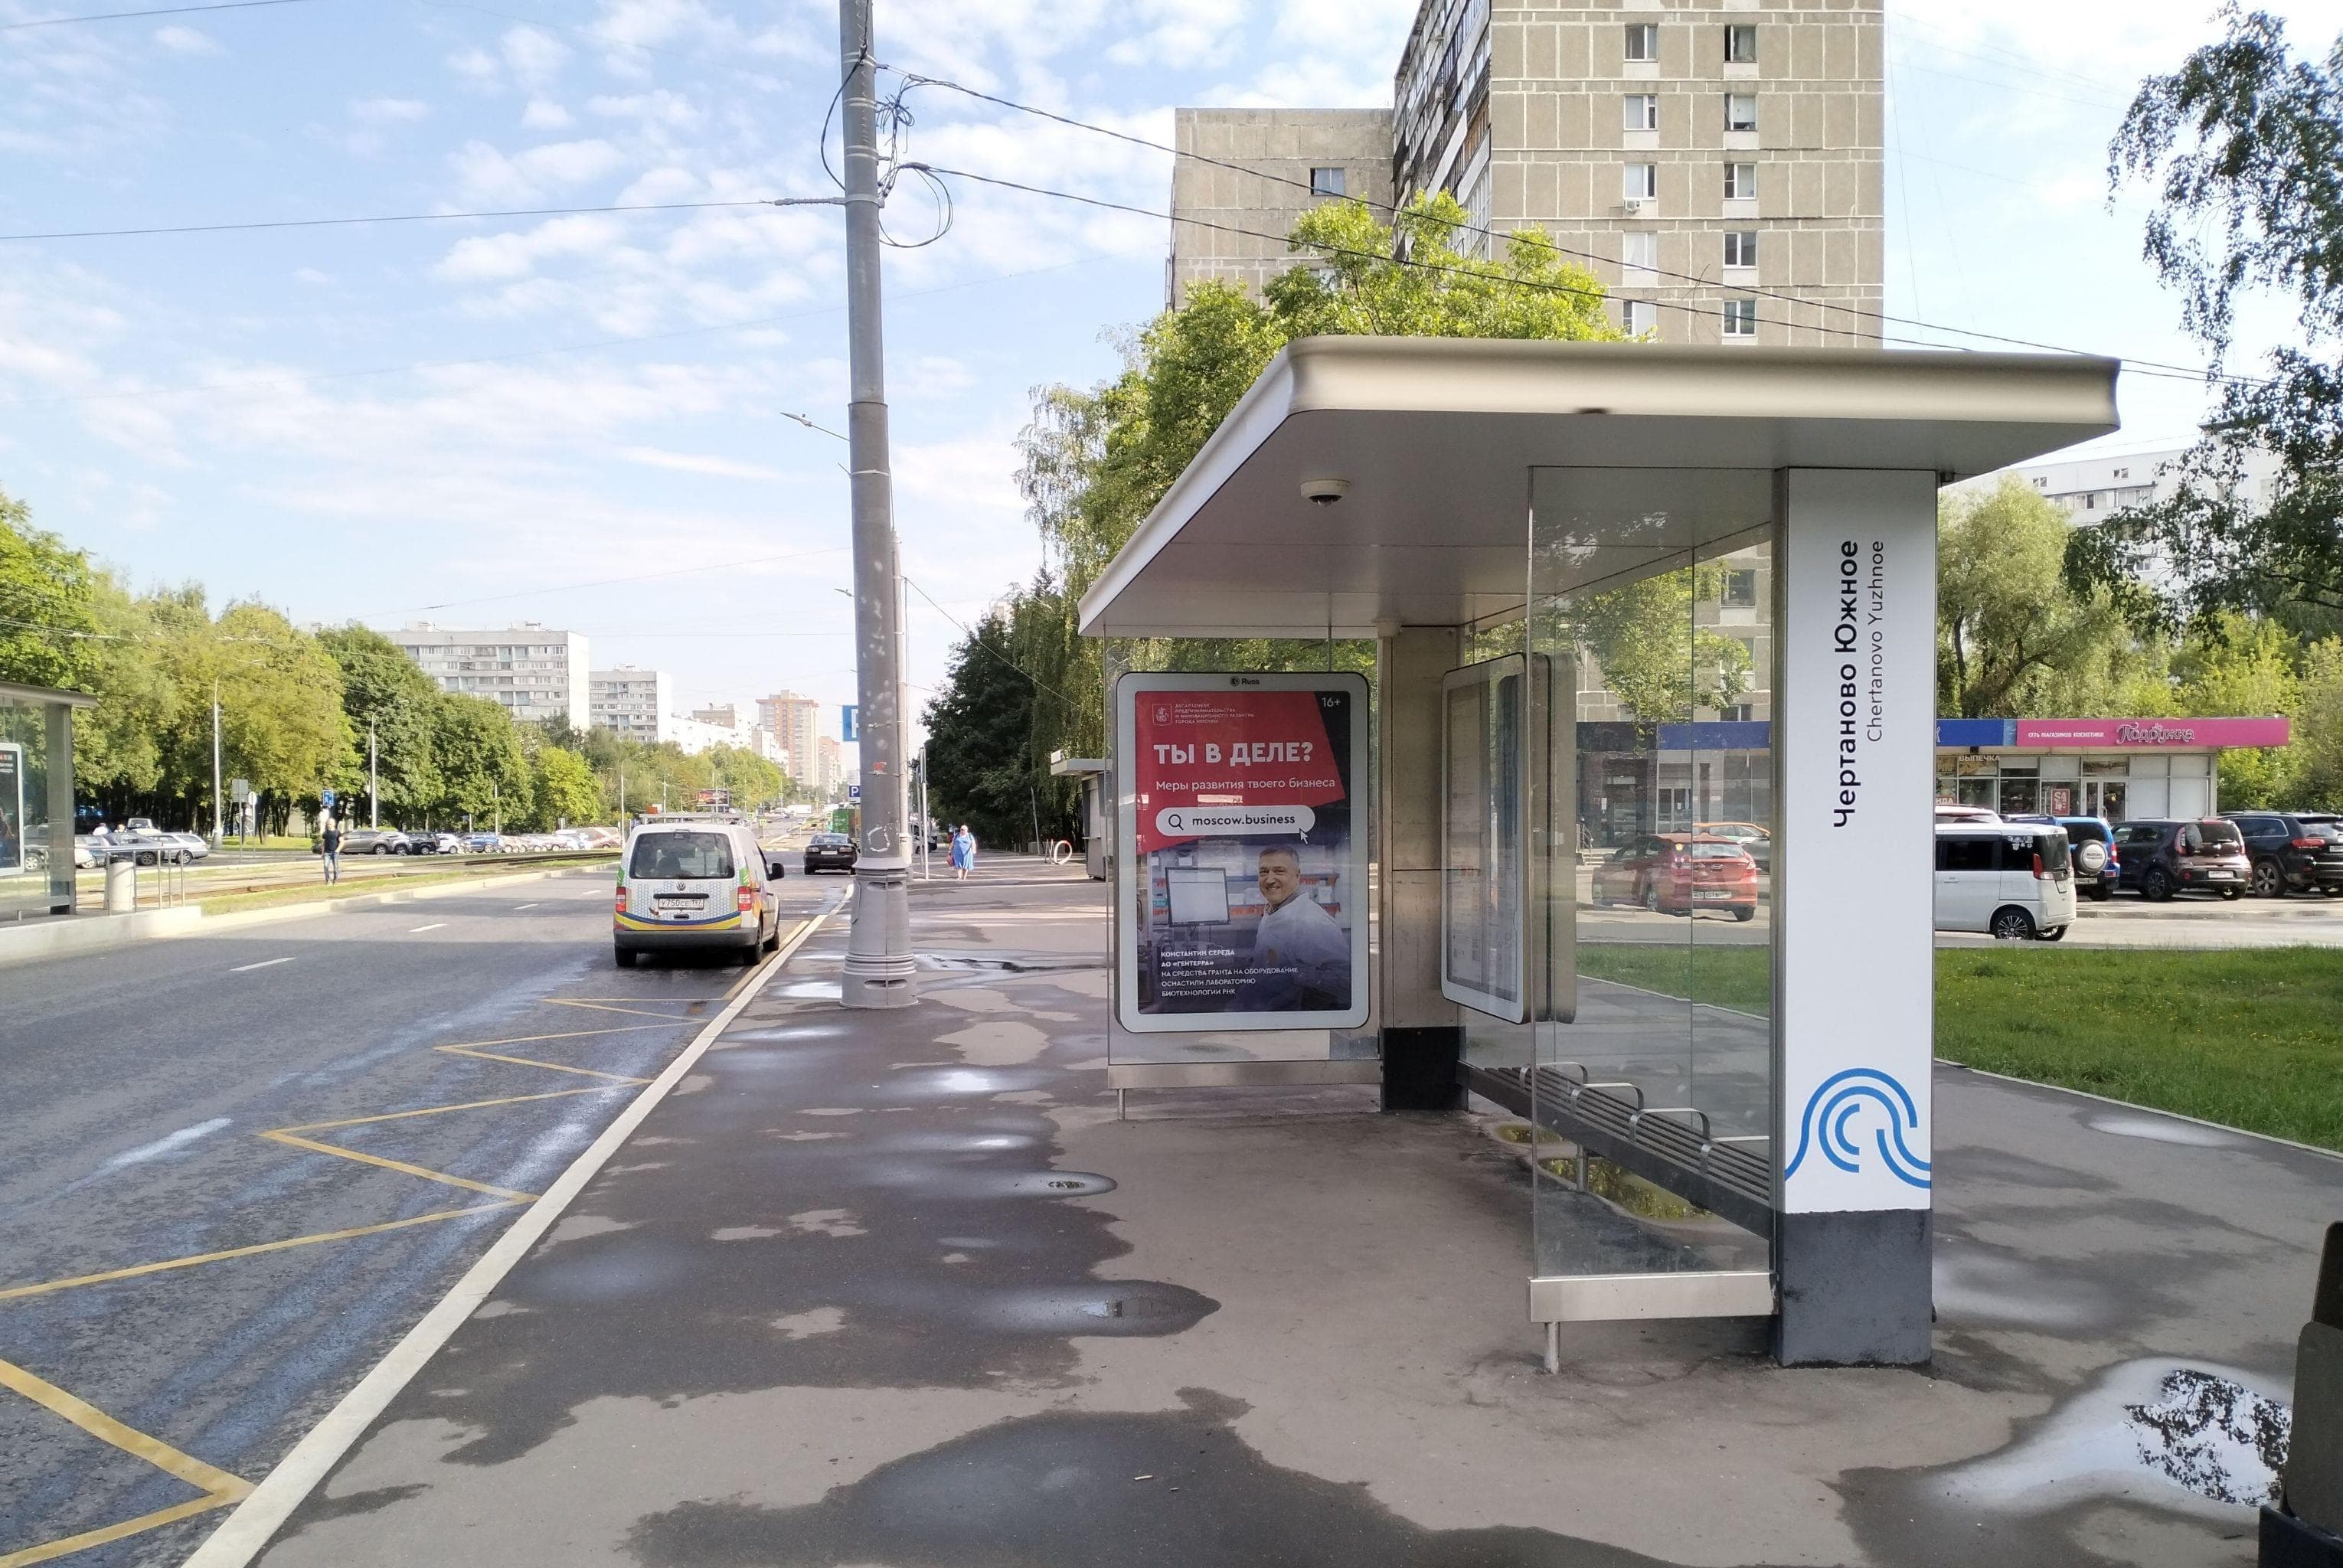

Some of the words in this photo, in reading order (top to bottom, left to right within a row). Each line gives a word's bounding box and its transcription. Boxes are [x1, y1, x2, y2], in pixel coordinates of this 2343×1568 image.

[1867, 540, 1884, 627] Yuzhnoe
[1834, 539, 1859, 653] Южное
[1867, 629, 1884, 742] Chertanovo
[1322, 697, 1341, 708] 16+
[2116, 722, 2195, 744] Подружка
[1153, 743, 1194, 764] ТЫ
[1205, 743, 1222, 763] В
[1230, 741, 1313, 766] ДЕЛЕ?
[1833, 663, 1861, 828] Чертаново
[1959, 754, 2001, 763] ВЫПЕЧКА
[1155, 780, 1189, 792] Меры
[1191, 779, 1244, 792] развития
[1247, 779, 1286, 789] твоего
[1289, 776, 1335, 789] бизнеса
[1191, 813, 1296, 826] moscow.business
[1205, 978, 1256, 986] ЛАБОРАТОРИЮ
